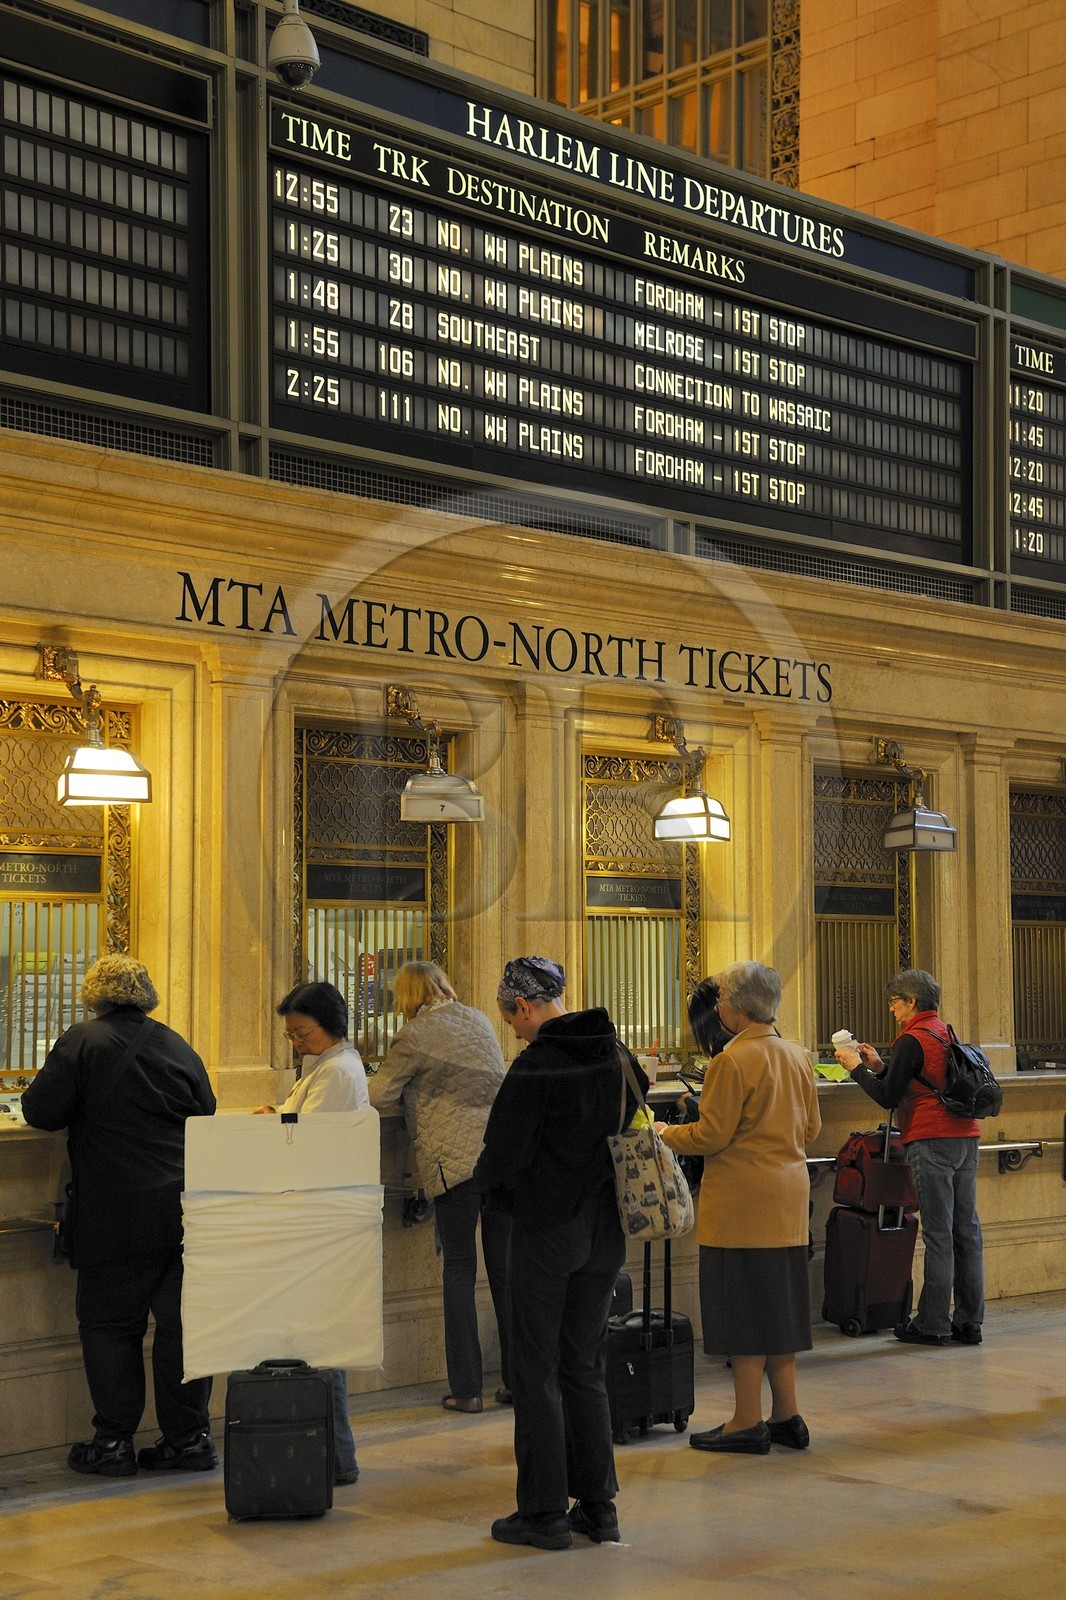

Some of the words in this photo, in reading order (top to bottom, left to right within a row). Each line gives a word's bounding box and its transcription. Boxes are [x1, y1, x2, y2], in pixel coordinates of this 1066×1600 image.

[282, 113, 351, 160] TIME
[374, 143, 430, 186] TRK
[448, 168, 610, 243] DESTINATION
[644, 231, 745, 283] REMARKS
[467, 102, 600, 178] HARLEM
[609, 153, 674, 202] LINE
[683, 178, 844, 257] DEPARTURES
[276, 170, 338, 213] 12:55
[390, 206, 412, 236] 23
[438, 220, 468, 252] NO.
[485, 234, 506, 264] WH
[519, 245, 583, 285] PLAINS
[635, 279, 703, 319] FORDHAM
[735, 308, 759, 335] 1ST
[770, 319, 804, 347] STOP
[289, 224, 338, 262] 1:25
[390, 253, 412, 283] 30
[438, 266, 469, 298] NO.
[485, 280, 506, 309] WH
[519, 289, 583, 329] PLAINS
[635, 322, 703, 361] MELROSE
[734, 349, 759, 375] 1ST
[770, 359, 805, 386] STOP
[289, 273, 338, 309] 1:48
[390, 300, 412, 329] 28
[438, 313, 539, 362] SOUTHEAST
[635, 365, 732, 409] CONNECTION
[742, 391, 759, 416] TO
[770, 402, 830, 433] WASSAIC
[290, 321, 338, 357] 1:55
[380, 345, 413, 376] 106
[438, 358, 468, 389] NO.
[485, 370, 506, 398] WH
[520, 378, 582, 415] PLAINS
[635, 406, 703, 443] FORDHAM
[735, 430, 759, 455] 1ST
[770, 439, 805, 465] STOP
[1015, 345, 1053, 373] TIME
[288, 369, 338, 405] 2:25
[381, 391, 409, 421] 111
[439, 404, 468, 434] NO.
[485, 415, 506, 442] WH
[520, 423, 582, 458] PLAINS
[636, 449, 703, 484] FORDHAM
[735, 471, 759, 495] 1ST
[770, 478, 805, 504] STOP
[1016, 530, 1043, 553] 1:20
[176, 571, 297, 637] MTA
[316, 594, 666, 683] METRO-NORTH
[679, 645, 833, 703] TICKETS
[2, 873, 46, 883] TICKETS
[599, 884, 614, 892] MTA
[616, 885, 666, 894] METRO-NORTH
[619, 894, 647, 902] TICKETS
